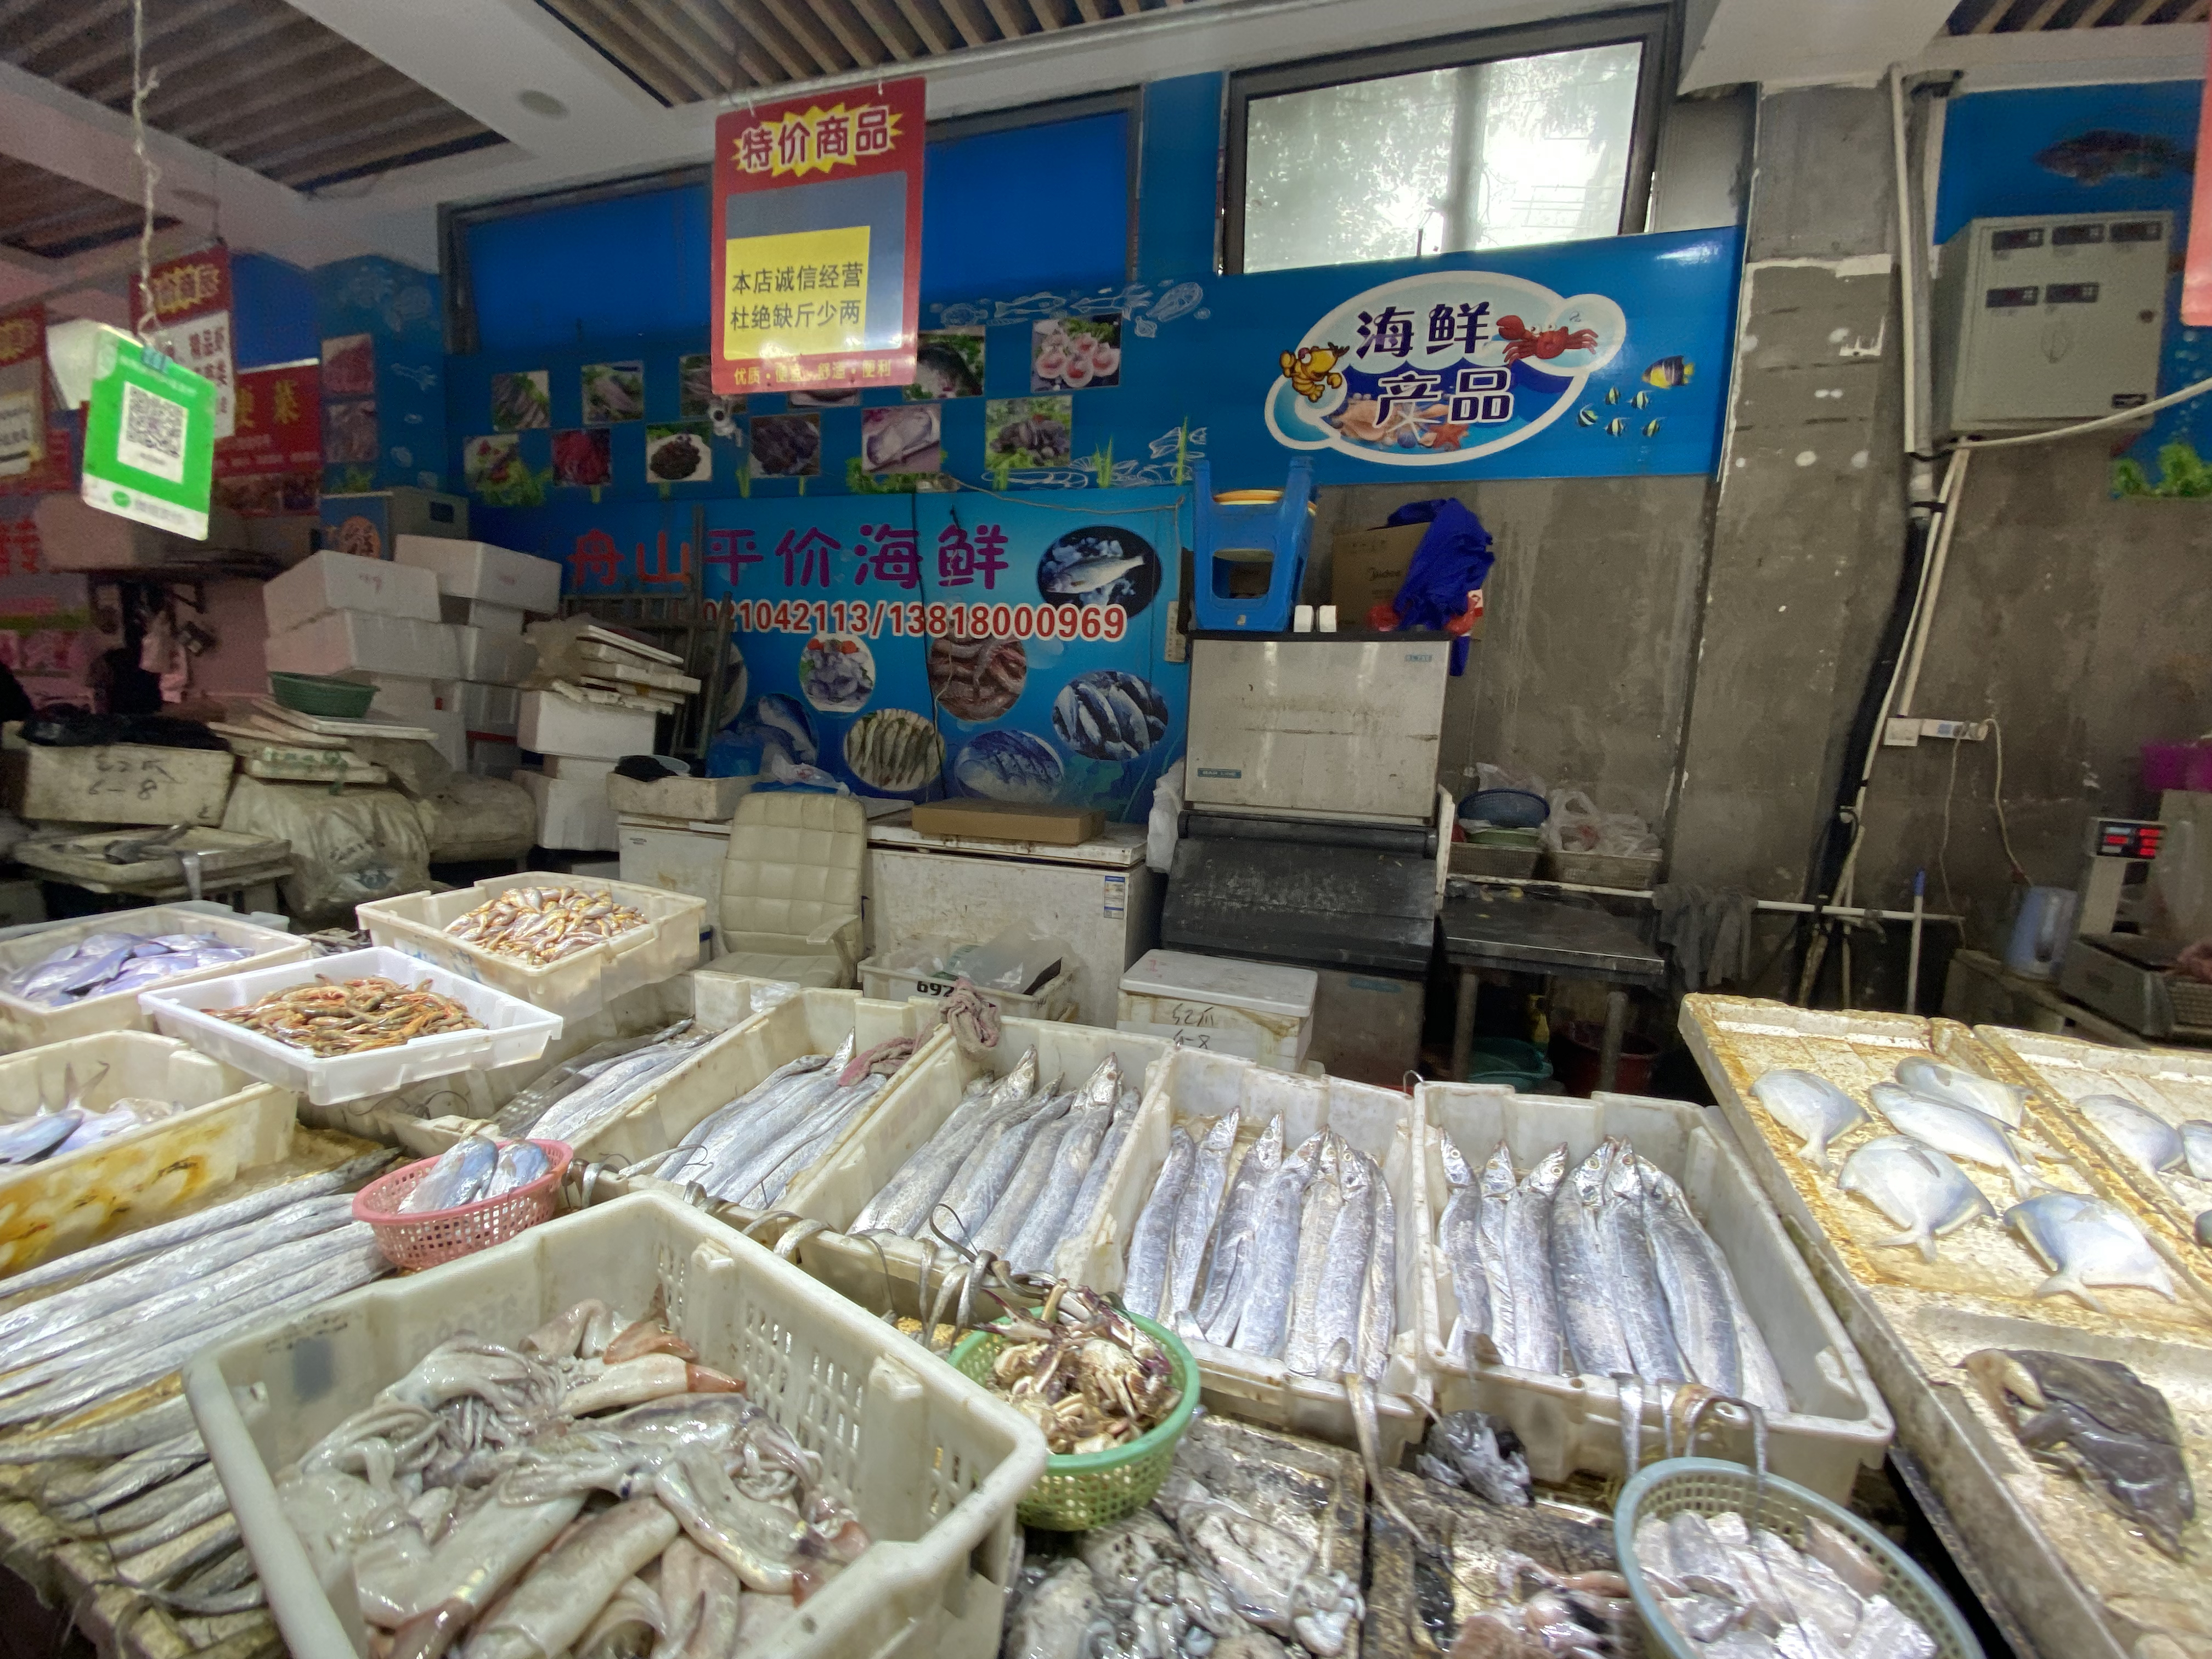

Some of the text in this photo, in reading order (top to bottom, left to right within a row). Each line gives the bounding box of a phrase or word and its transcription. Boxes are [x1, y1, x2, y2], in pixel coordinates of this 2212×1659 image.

[741, 106, 889, 172] 特价商品
[732, 261, 864, 295] 本店诚信经营
[730, 298, 862, 331] 杜绝缺斤少两
[1356, 302, 1491, 359] 海鲜
[1373, 368, 1513, 428] 产品
